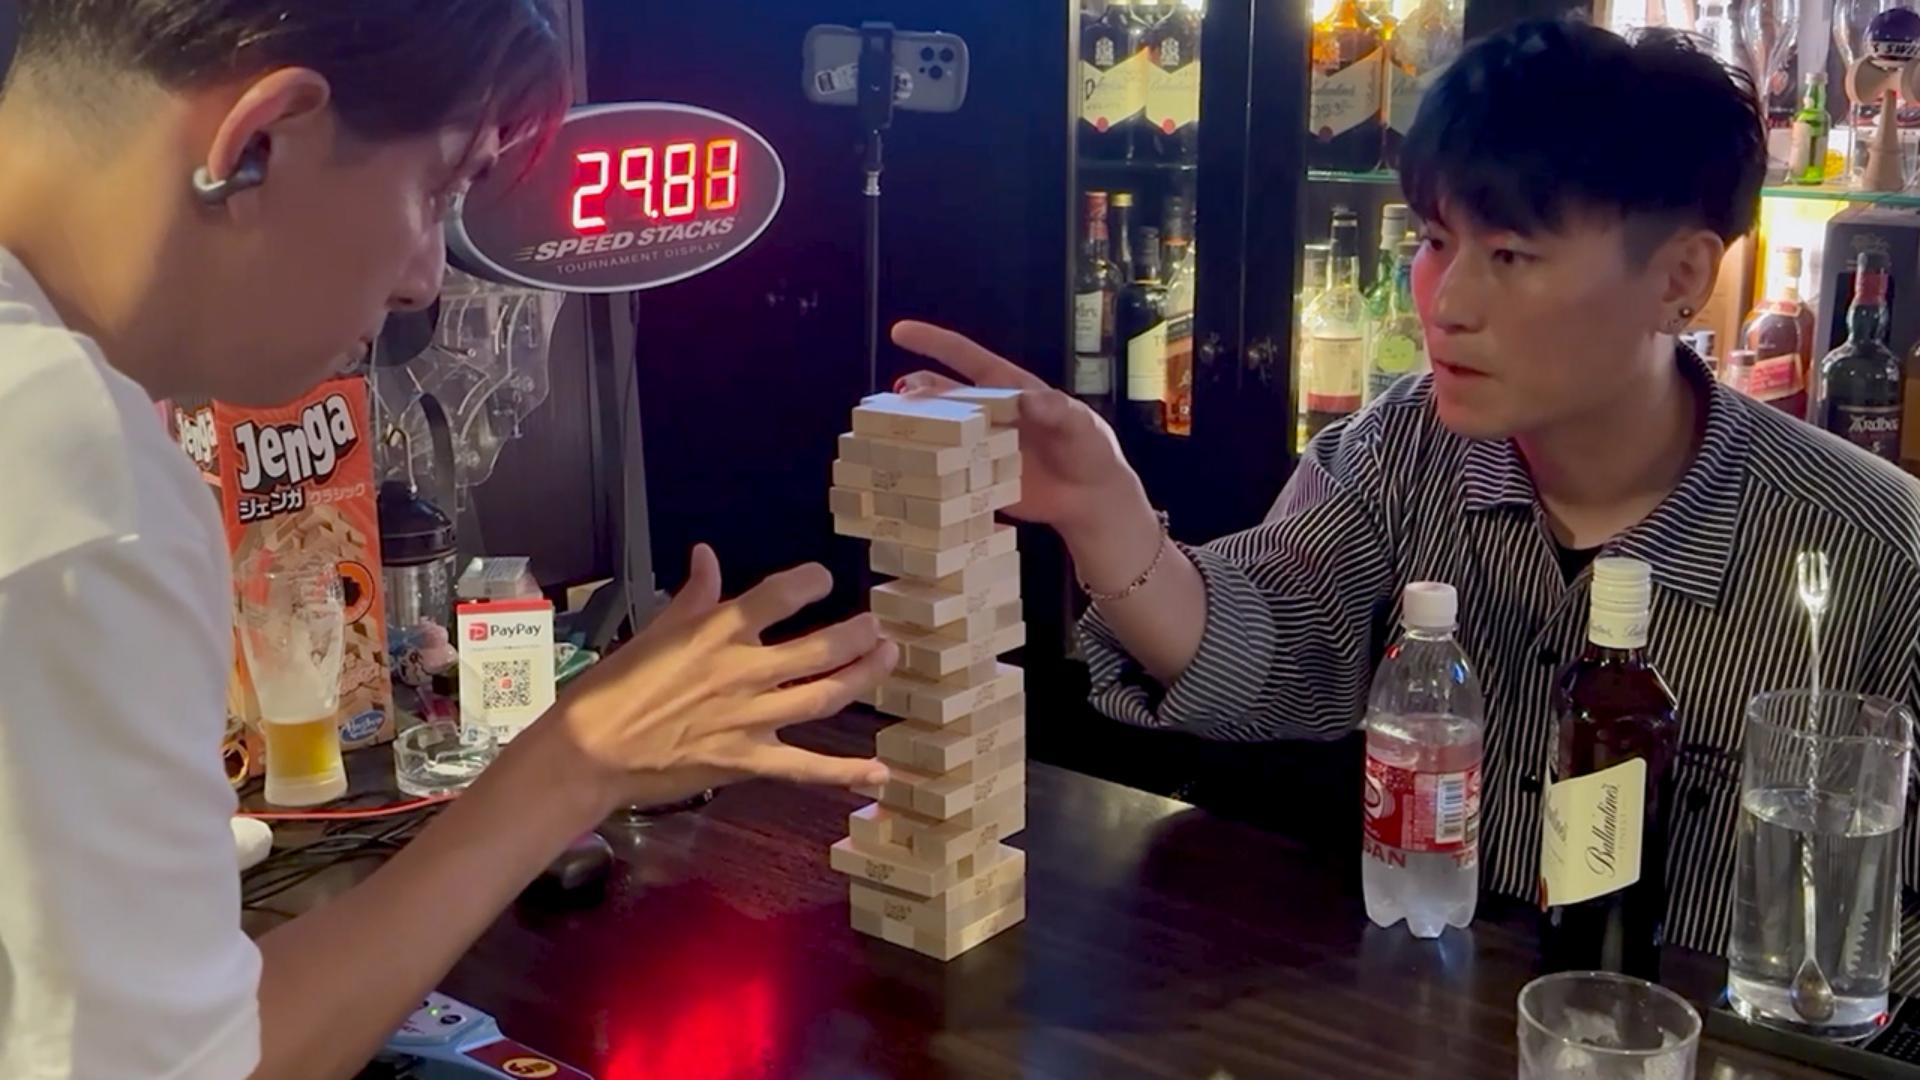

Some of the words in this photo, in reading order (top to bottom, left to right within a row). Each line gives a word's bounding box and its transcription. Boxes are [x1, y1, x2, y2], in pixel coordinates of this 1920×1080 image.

[534, 230, 634, 262] SPEED
[637, 216, 735, 247] STACKS
[556, 252, 659, 275] TOURNAMENT
[665, 241, 723, 261] DISPLAY
[235, 394, 357, 491] Jenga
[239, 487, 304, 521] ジェンガ
[307, 482, 366, 505] クラシック
[490, 623, 542, 637] PayPay
